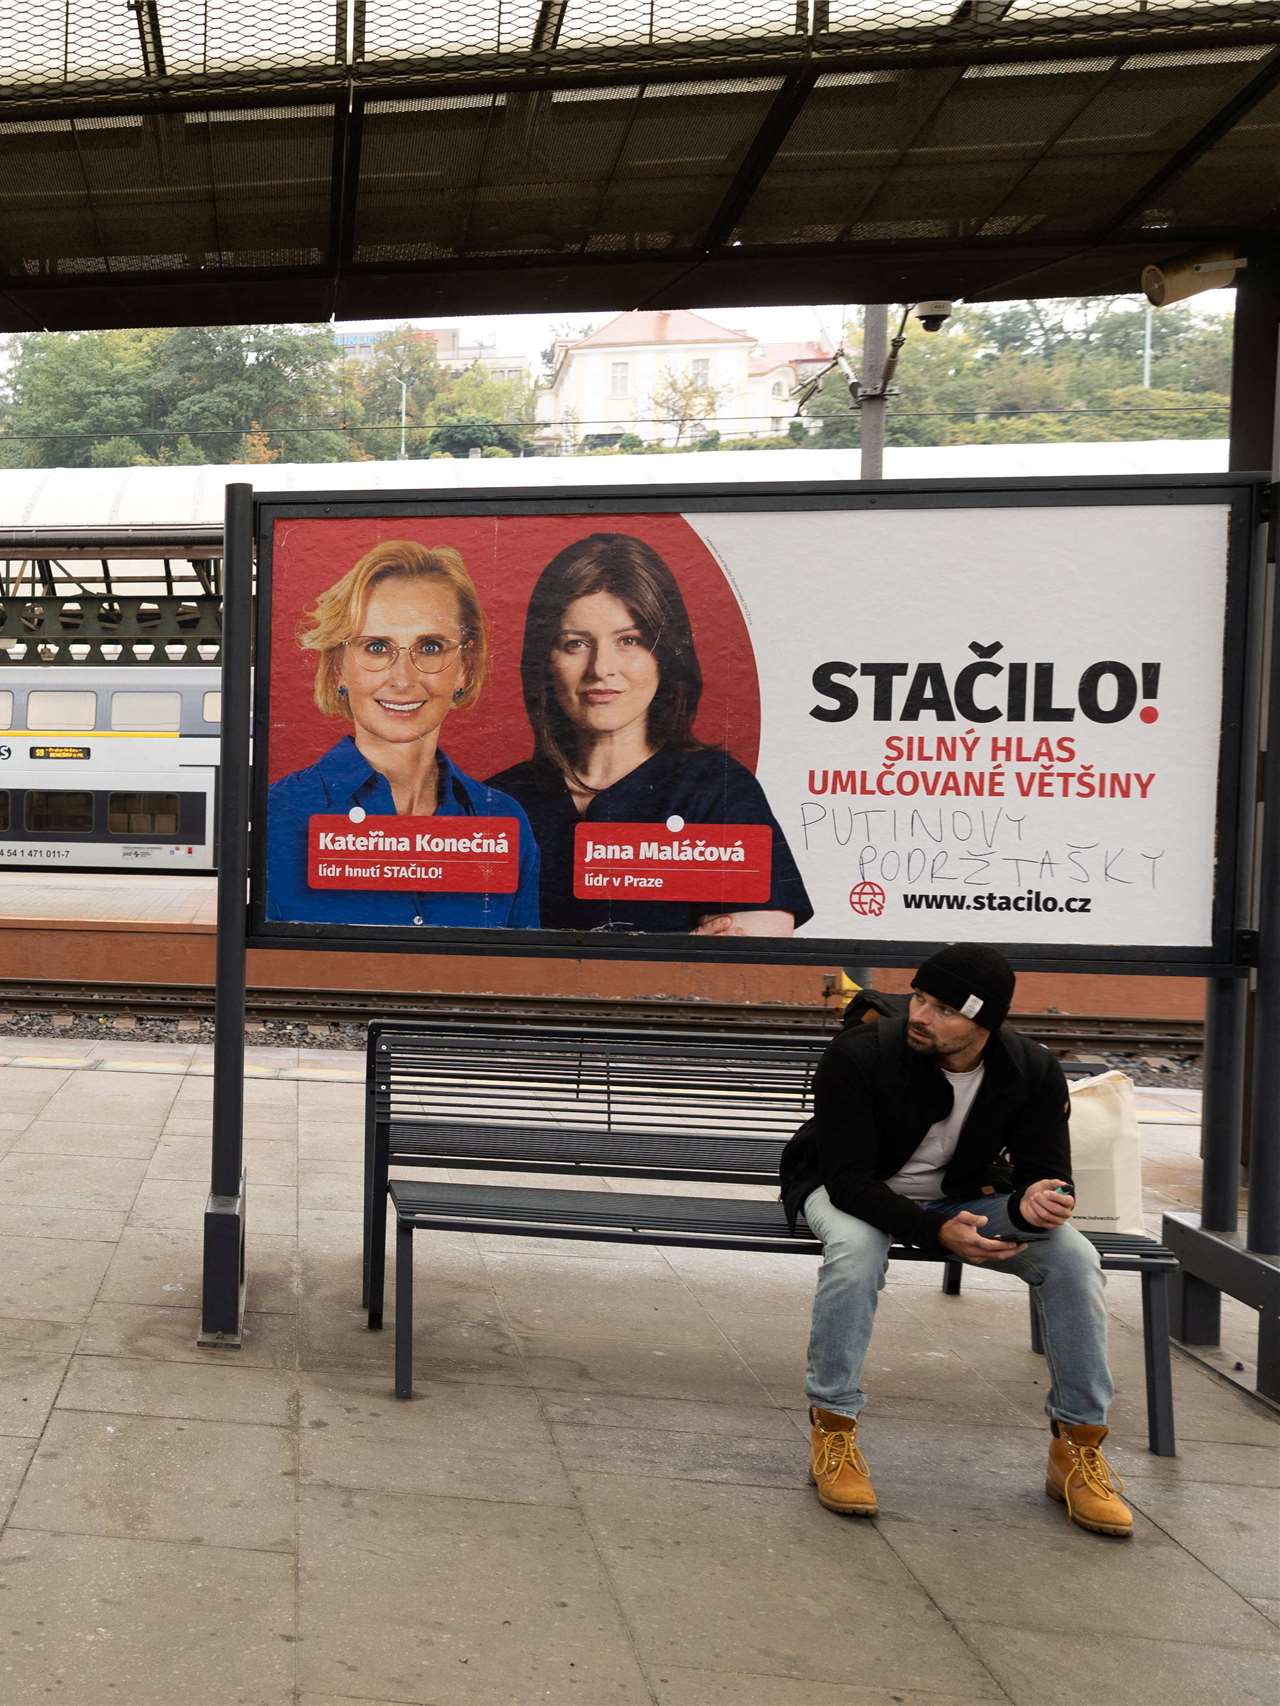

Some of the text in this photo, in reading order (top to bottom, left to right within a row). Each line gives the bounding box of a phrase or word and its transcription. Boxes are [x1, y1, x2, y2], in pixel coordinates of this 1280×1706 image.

[808, 640, 1162, 724] STAČILO!
[883, 728, 1077, 763] SILNÝ HLAS
[807, 762, 1157, 799] UMLČOVANÉ VĚTŠINY
[800, 802, 1027, 850] PUTINOVY
[7, 849, 17, 857] 54
[20, 849, 25, 857] 1
[28, 850, 43, 858] 471
[46, 850, 70, 858] 011-7
[319, 831, 509, 854] Kateřina Konečná
[584, 839, 745, 863] Jana Maláčová
[318, 864, 443, 879] lídr hnutí STAČILO!
[584, 873, 664, 888] lídr v Praze
[903, 889, 1092, 914] www.stacilo.cz
